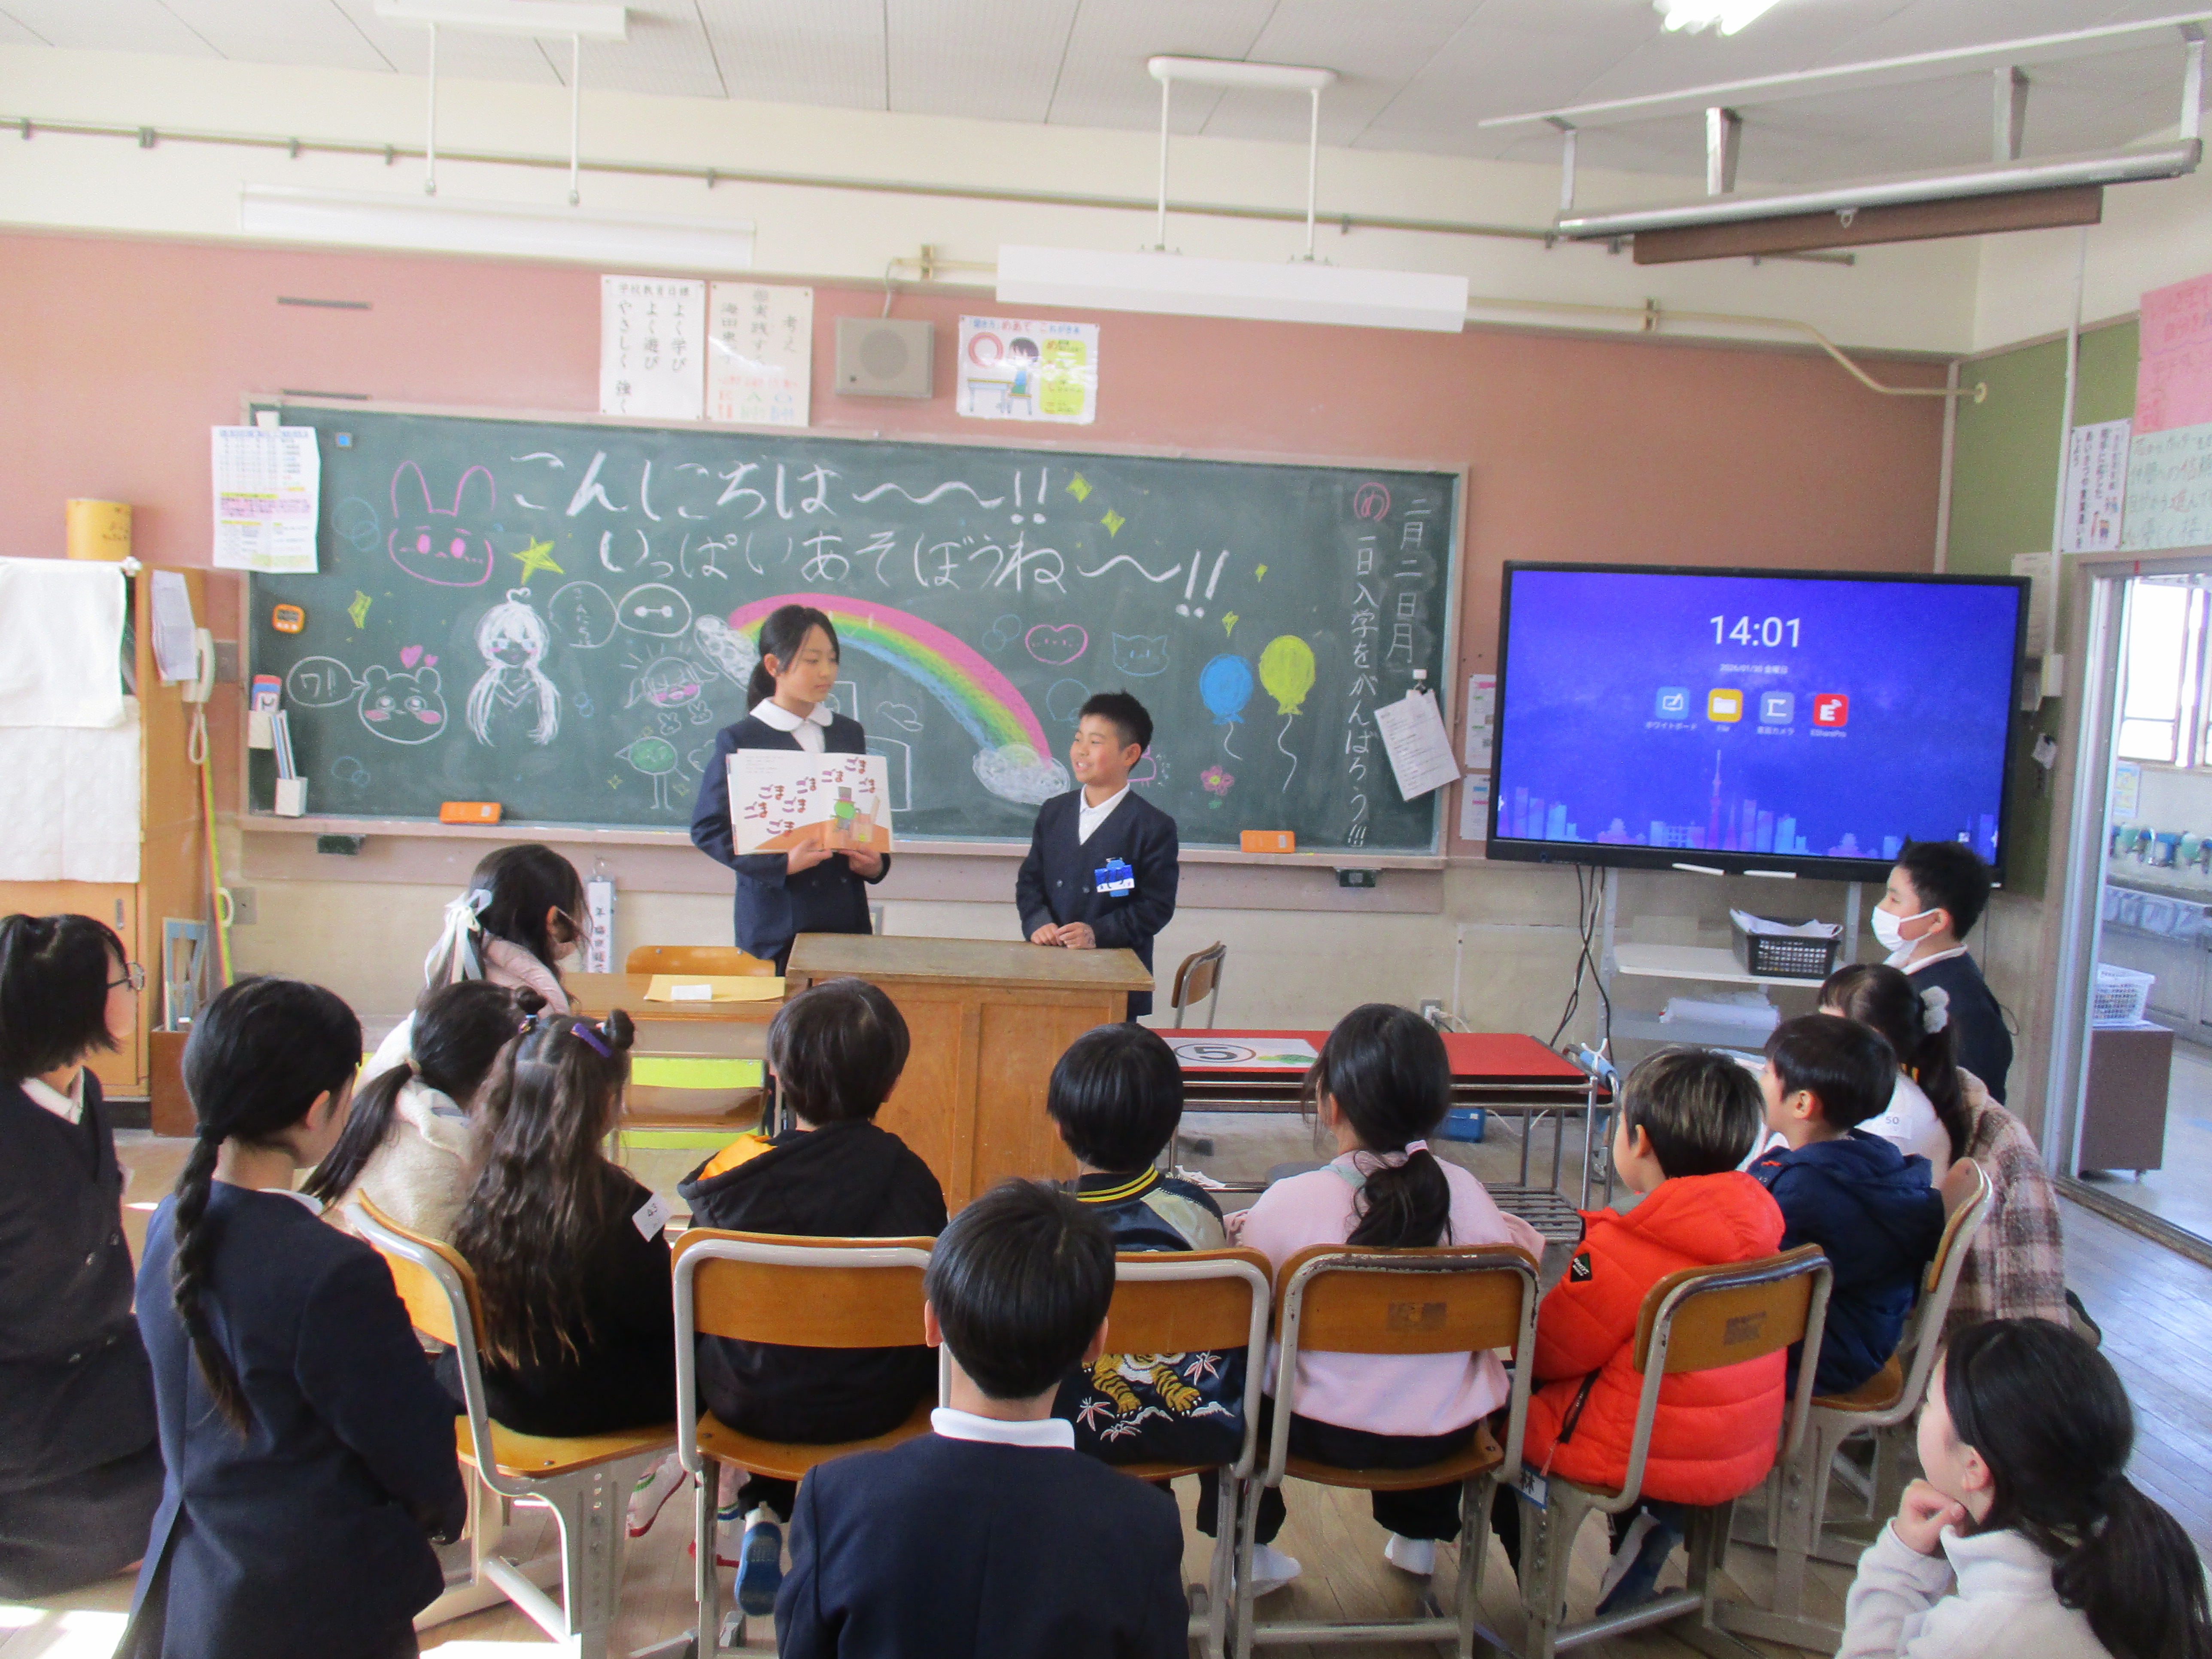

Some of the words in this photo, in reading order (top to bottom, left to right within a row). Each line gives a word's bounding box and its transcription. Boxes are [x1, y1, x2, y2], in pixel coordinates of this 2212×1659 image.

[617, 299, 632, 368] やさしく
[1710, 615, 1801, 647] 14:01
[1194, 1046, 1237, 1060] 5
